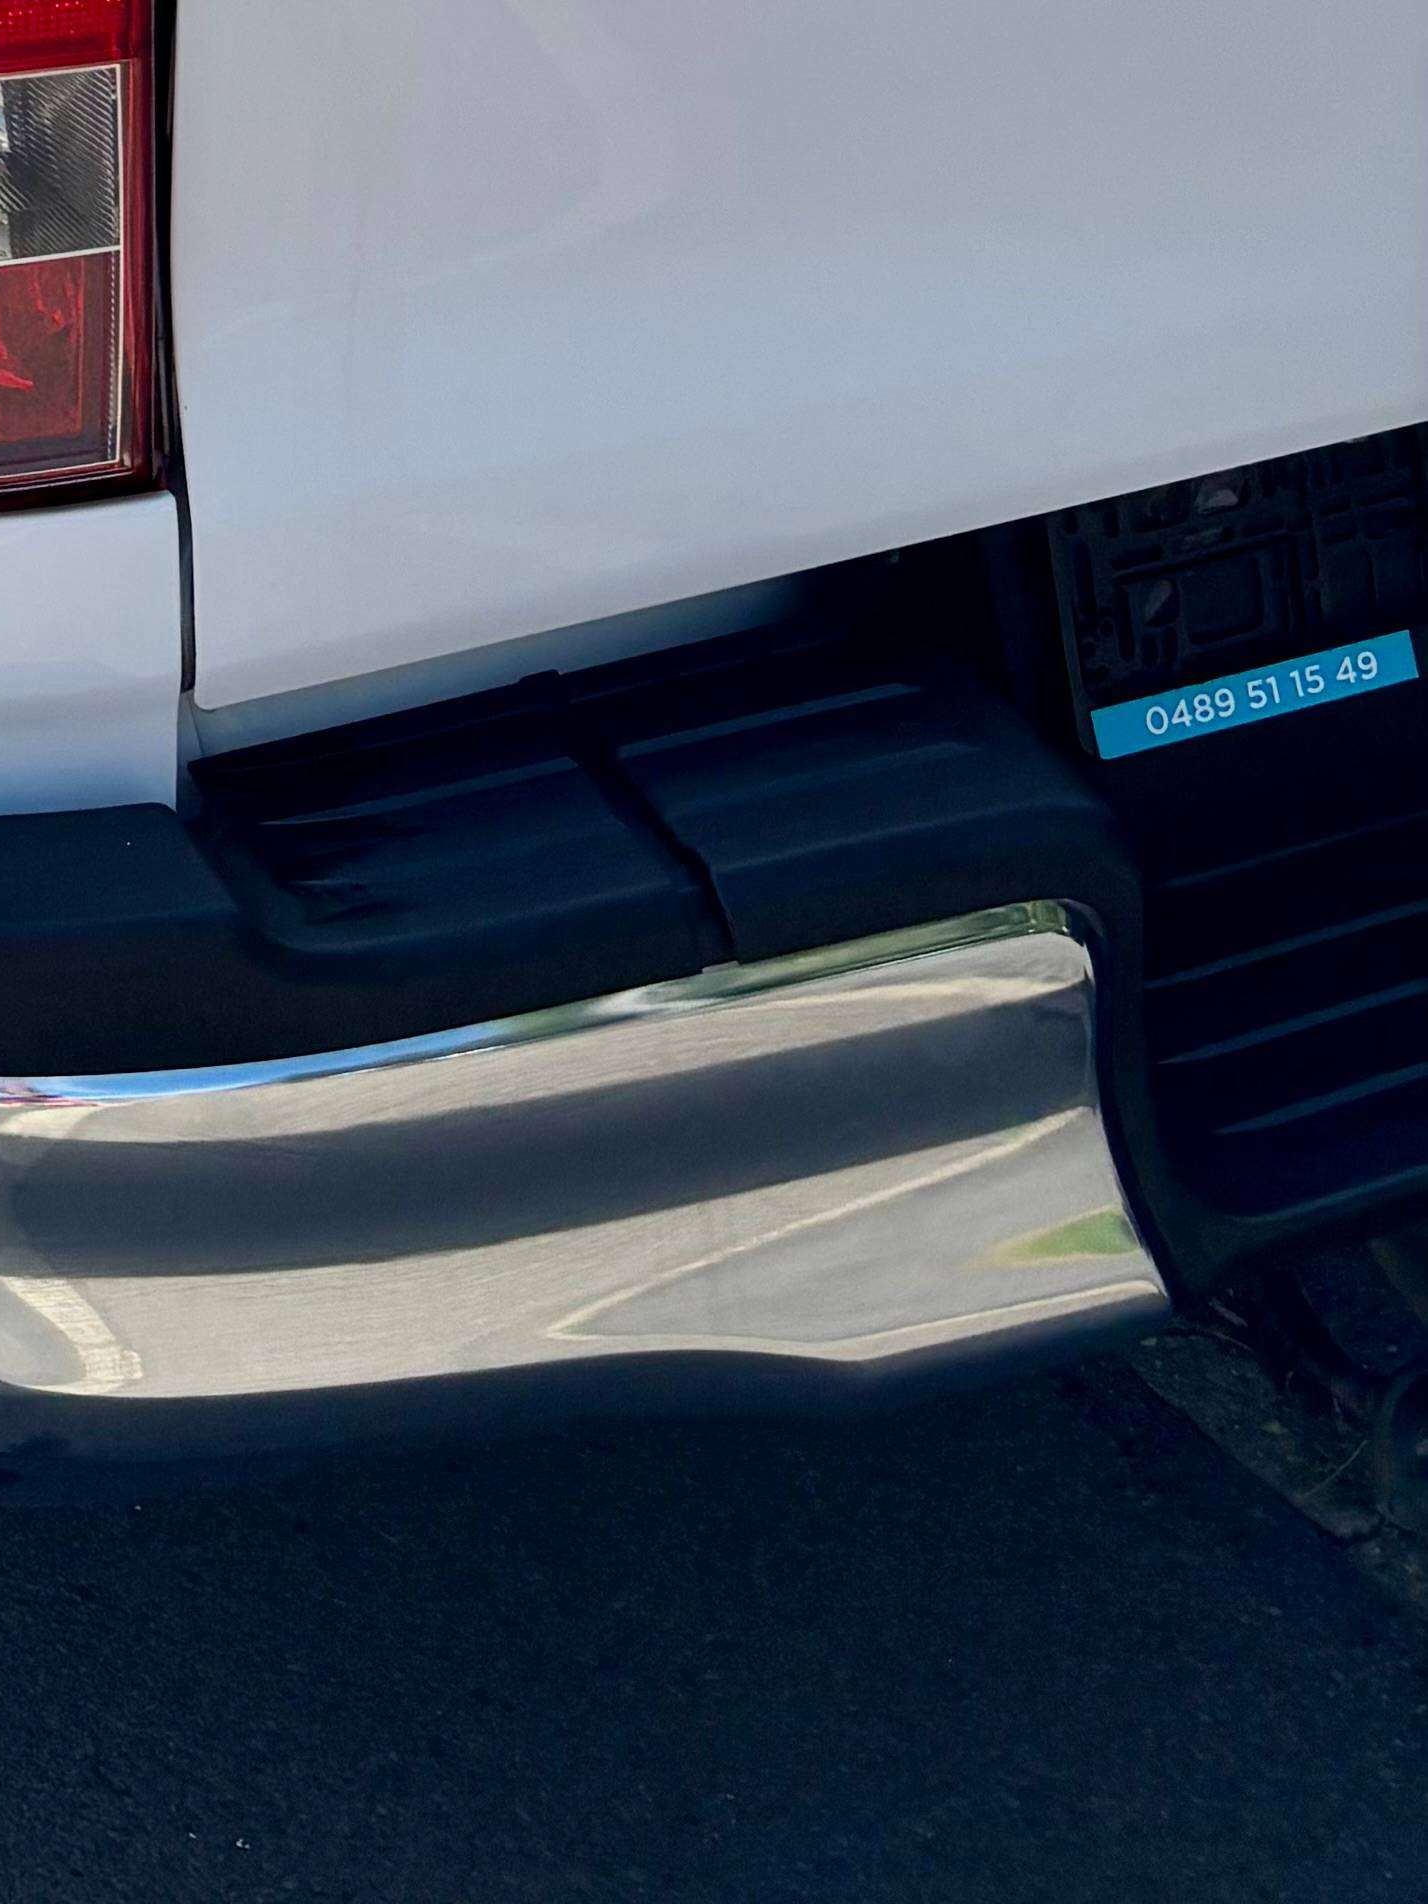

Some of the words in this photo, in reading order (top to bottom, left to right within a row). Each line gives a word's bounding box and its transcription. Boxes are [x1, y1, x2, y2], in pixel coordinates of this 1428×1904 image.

[1145, 688, 1236, 735] 0489
[1246, 676, 1281, 709] 51
[1289, 665, 1325, 697] 15
[1335, 651, 1378, 682] 49
